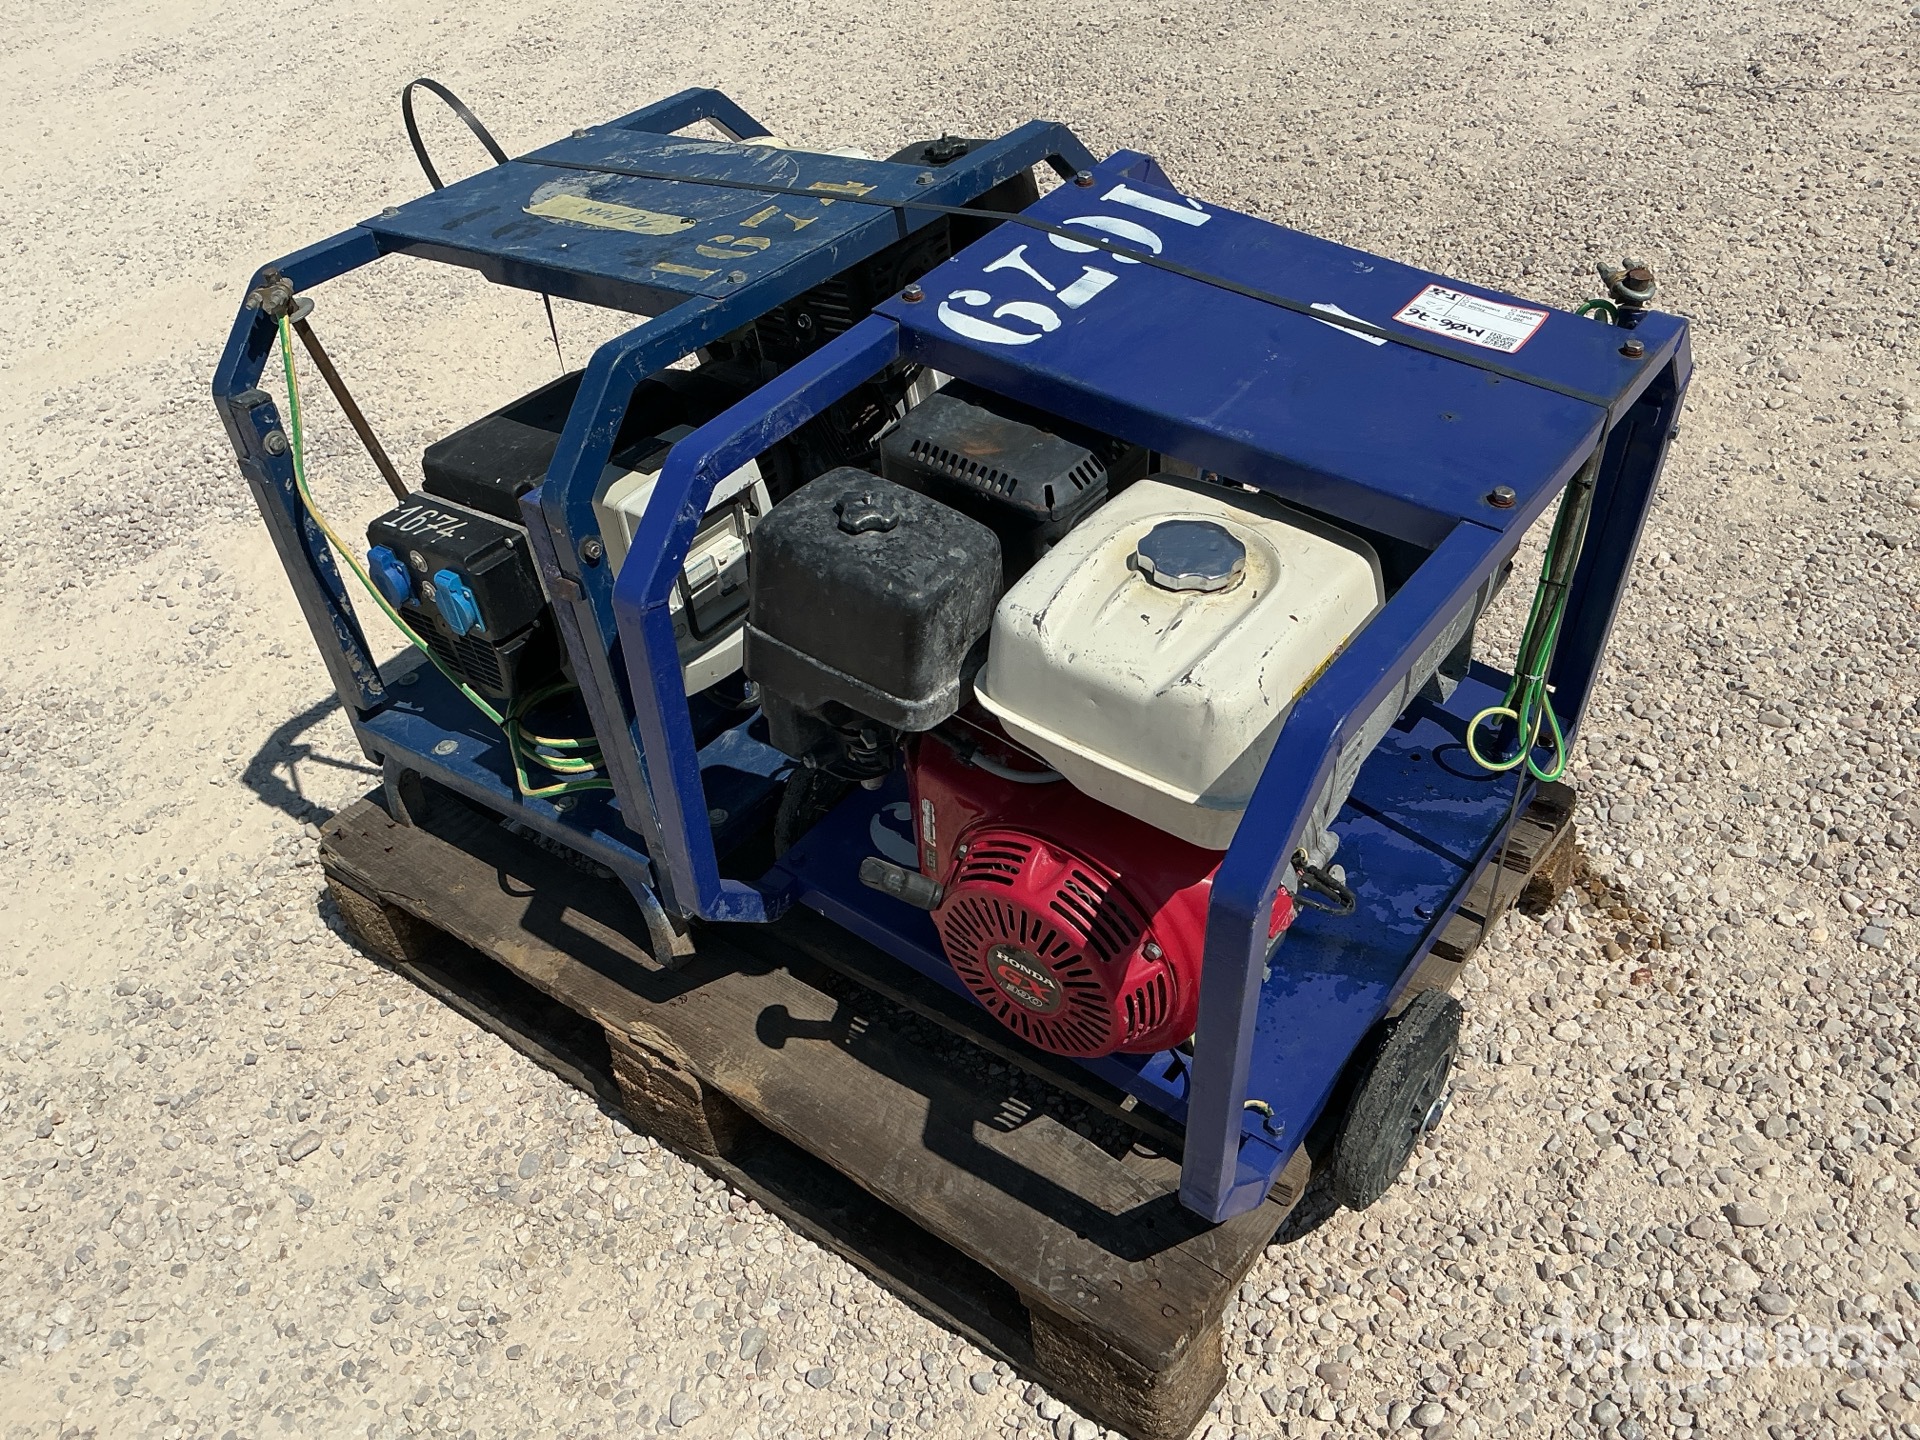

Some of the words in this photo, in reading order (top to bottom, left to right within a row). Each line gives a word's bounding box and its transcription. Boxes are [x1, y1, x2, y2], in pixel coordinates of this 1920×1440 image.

[937, 183, 1212, 346] 1679
[382, 505, 468, 543] 1674
[996, 950, 1056, 989] HONDA
[997, 965, 1052, 1003] GX
